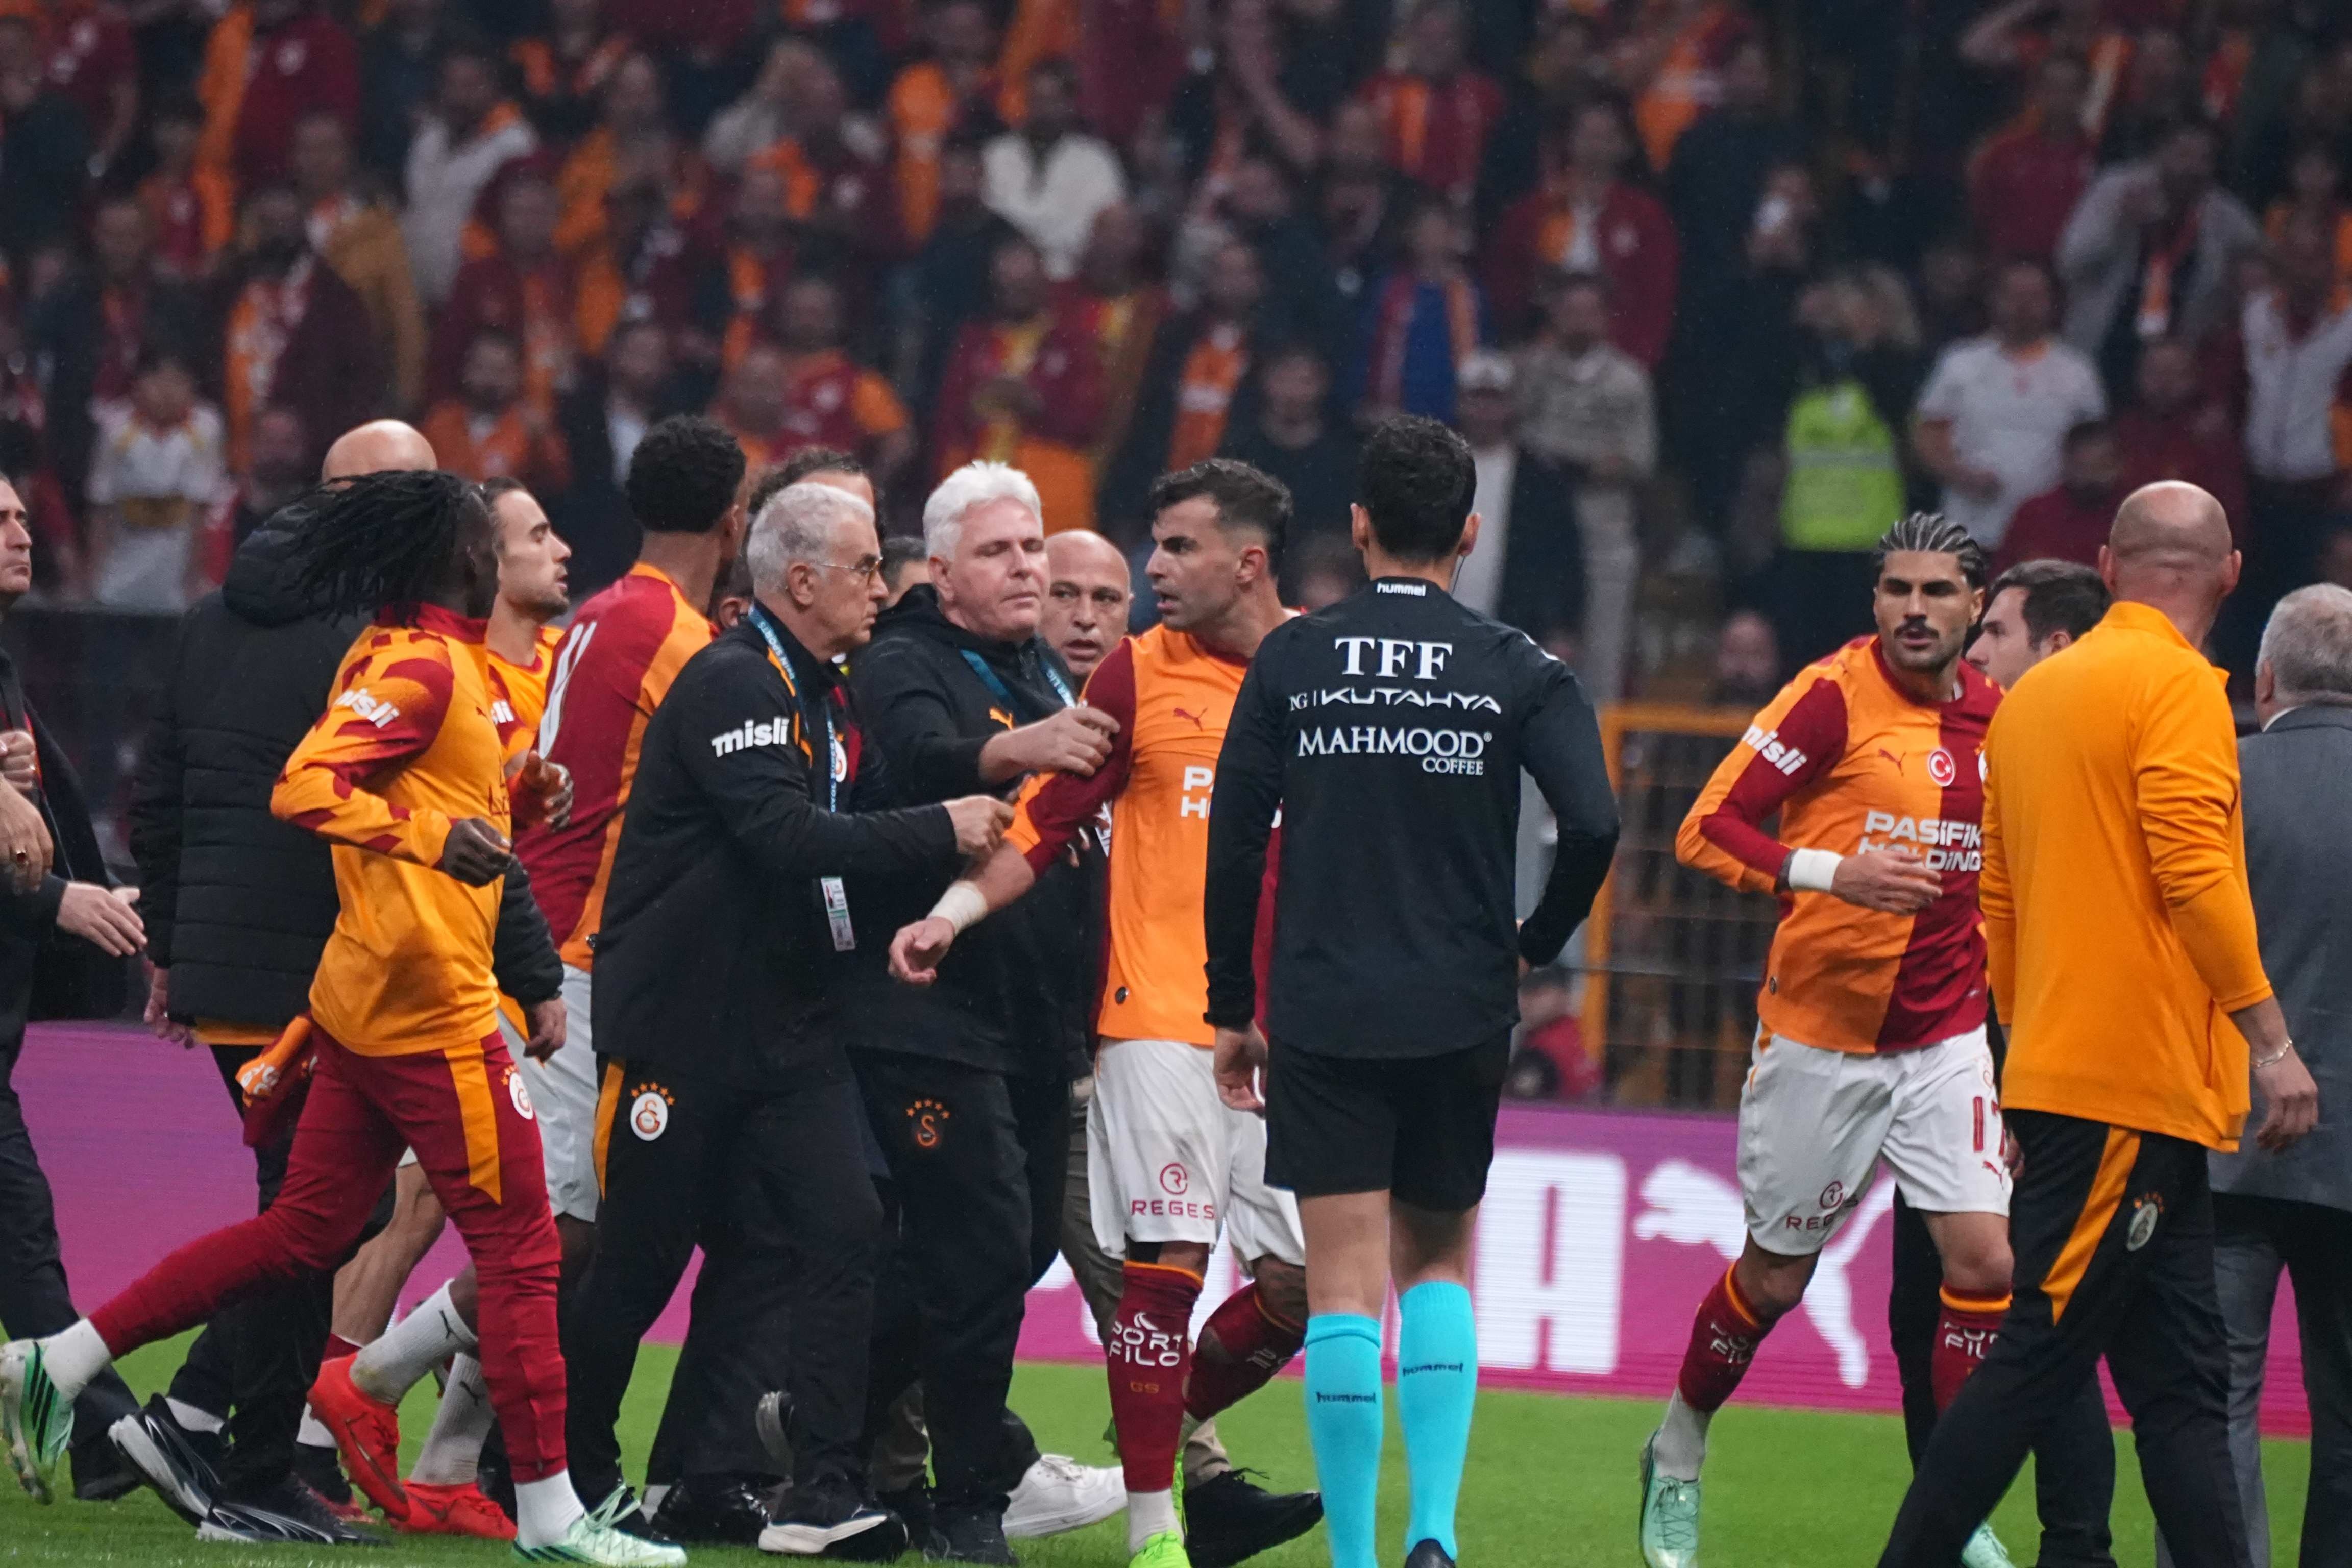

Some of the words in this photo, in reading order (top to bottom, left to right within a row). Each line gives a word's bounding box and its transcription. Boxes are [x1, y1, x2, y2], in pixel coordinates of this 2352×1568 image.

[1377, 583, 1426, 597] hummel
[1334, 636, 1452, 680] TFF
[1289, 693, 1308, 712] NG
[711, 716, 790, 757] misli
[1422, 757, 1484, 776] COFFEE
[1131, 1200, 1215, 1220] REGES
[1402, 1363, 1464, 1377] hummel
[1316, 1391, 1376, 1403] hummel
